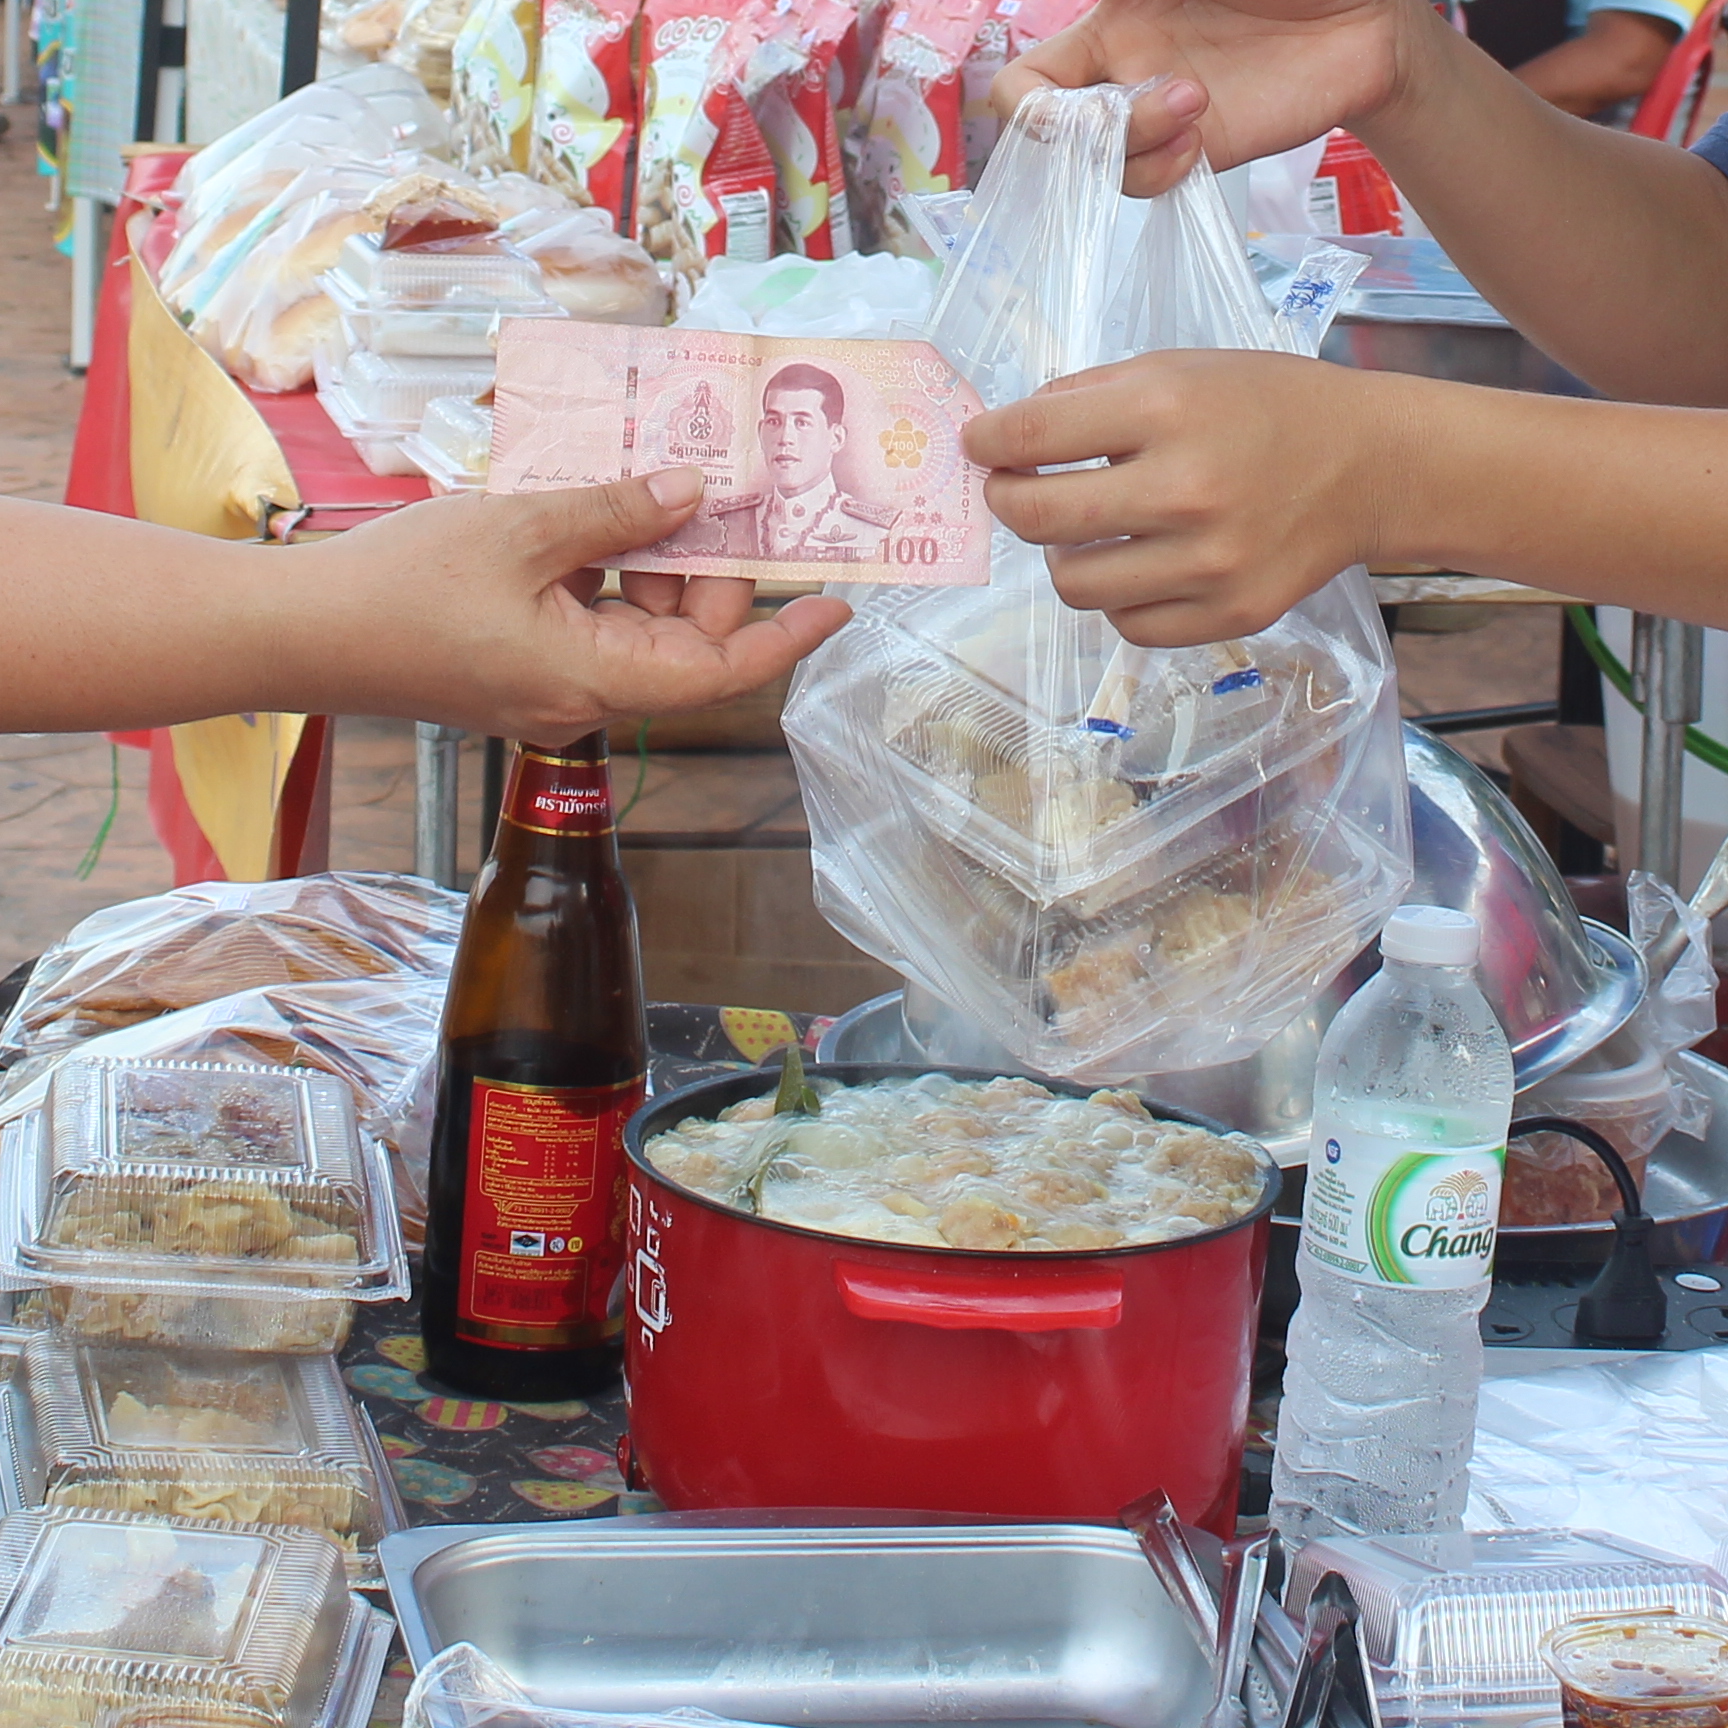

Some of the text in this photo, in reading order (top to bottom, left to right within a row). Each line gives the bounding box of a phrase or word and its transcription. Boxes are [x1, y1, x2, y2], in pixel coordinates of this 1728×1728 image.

[656, 16, 723, 50] COCO
[669, 442, 728, 459] รัฐบาลไทย
[893, 440, 914, 451] 100
[879, 537, 939, 565] 100
[1400, 1223, 1495, 1260] Chang
